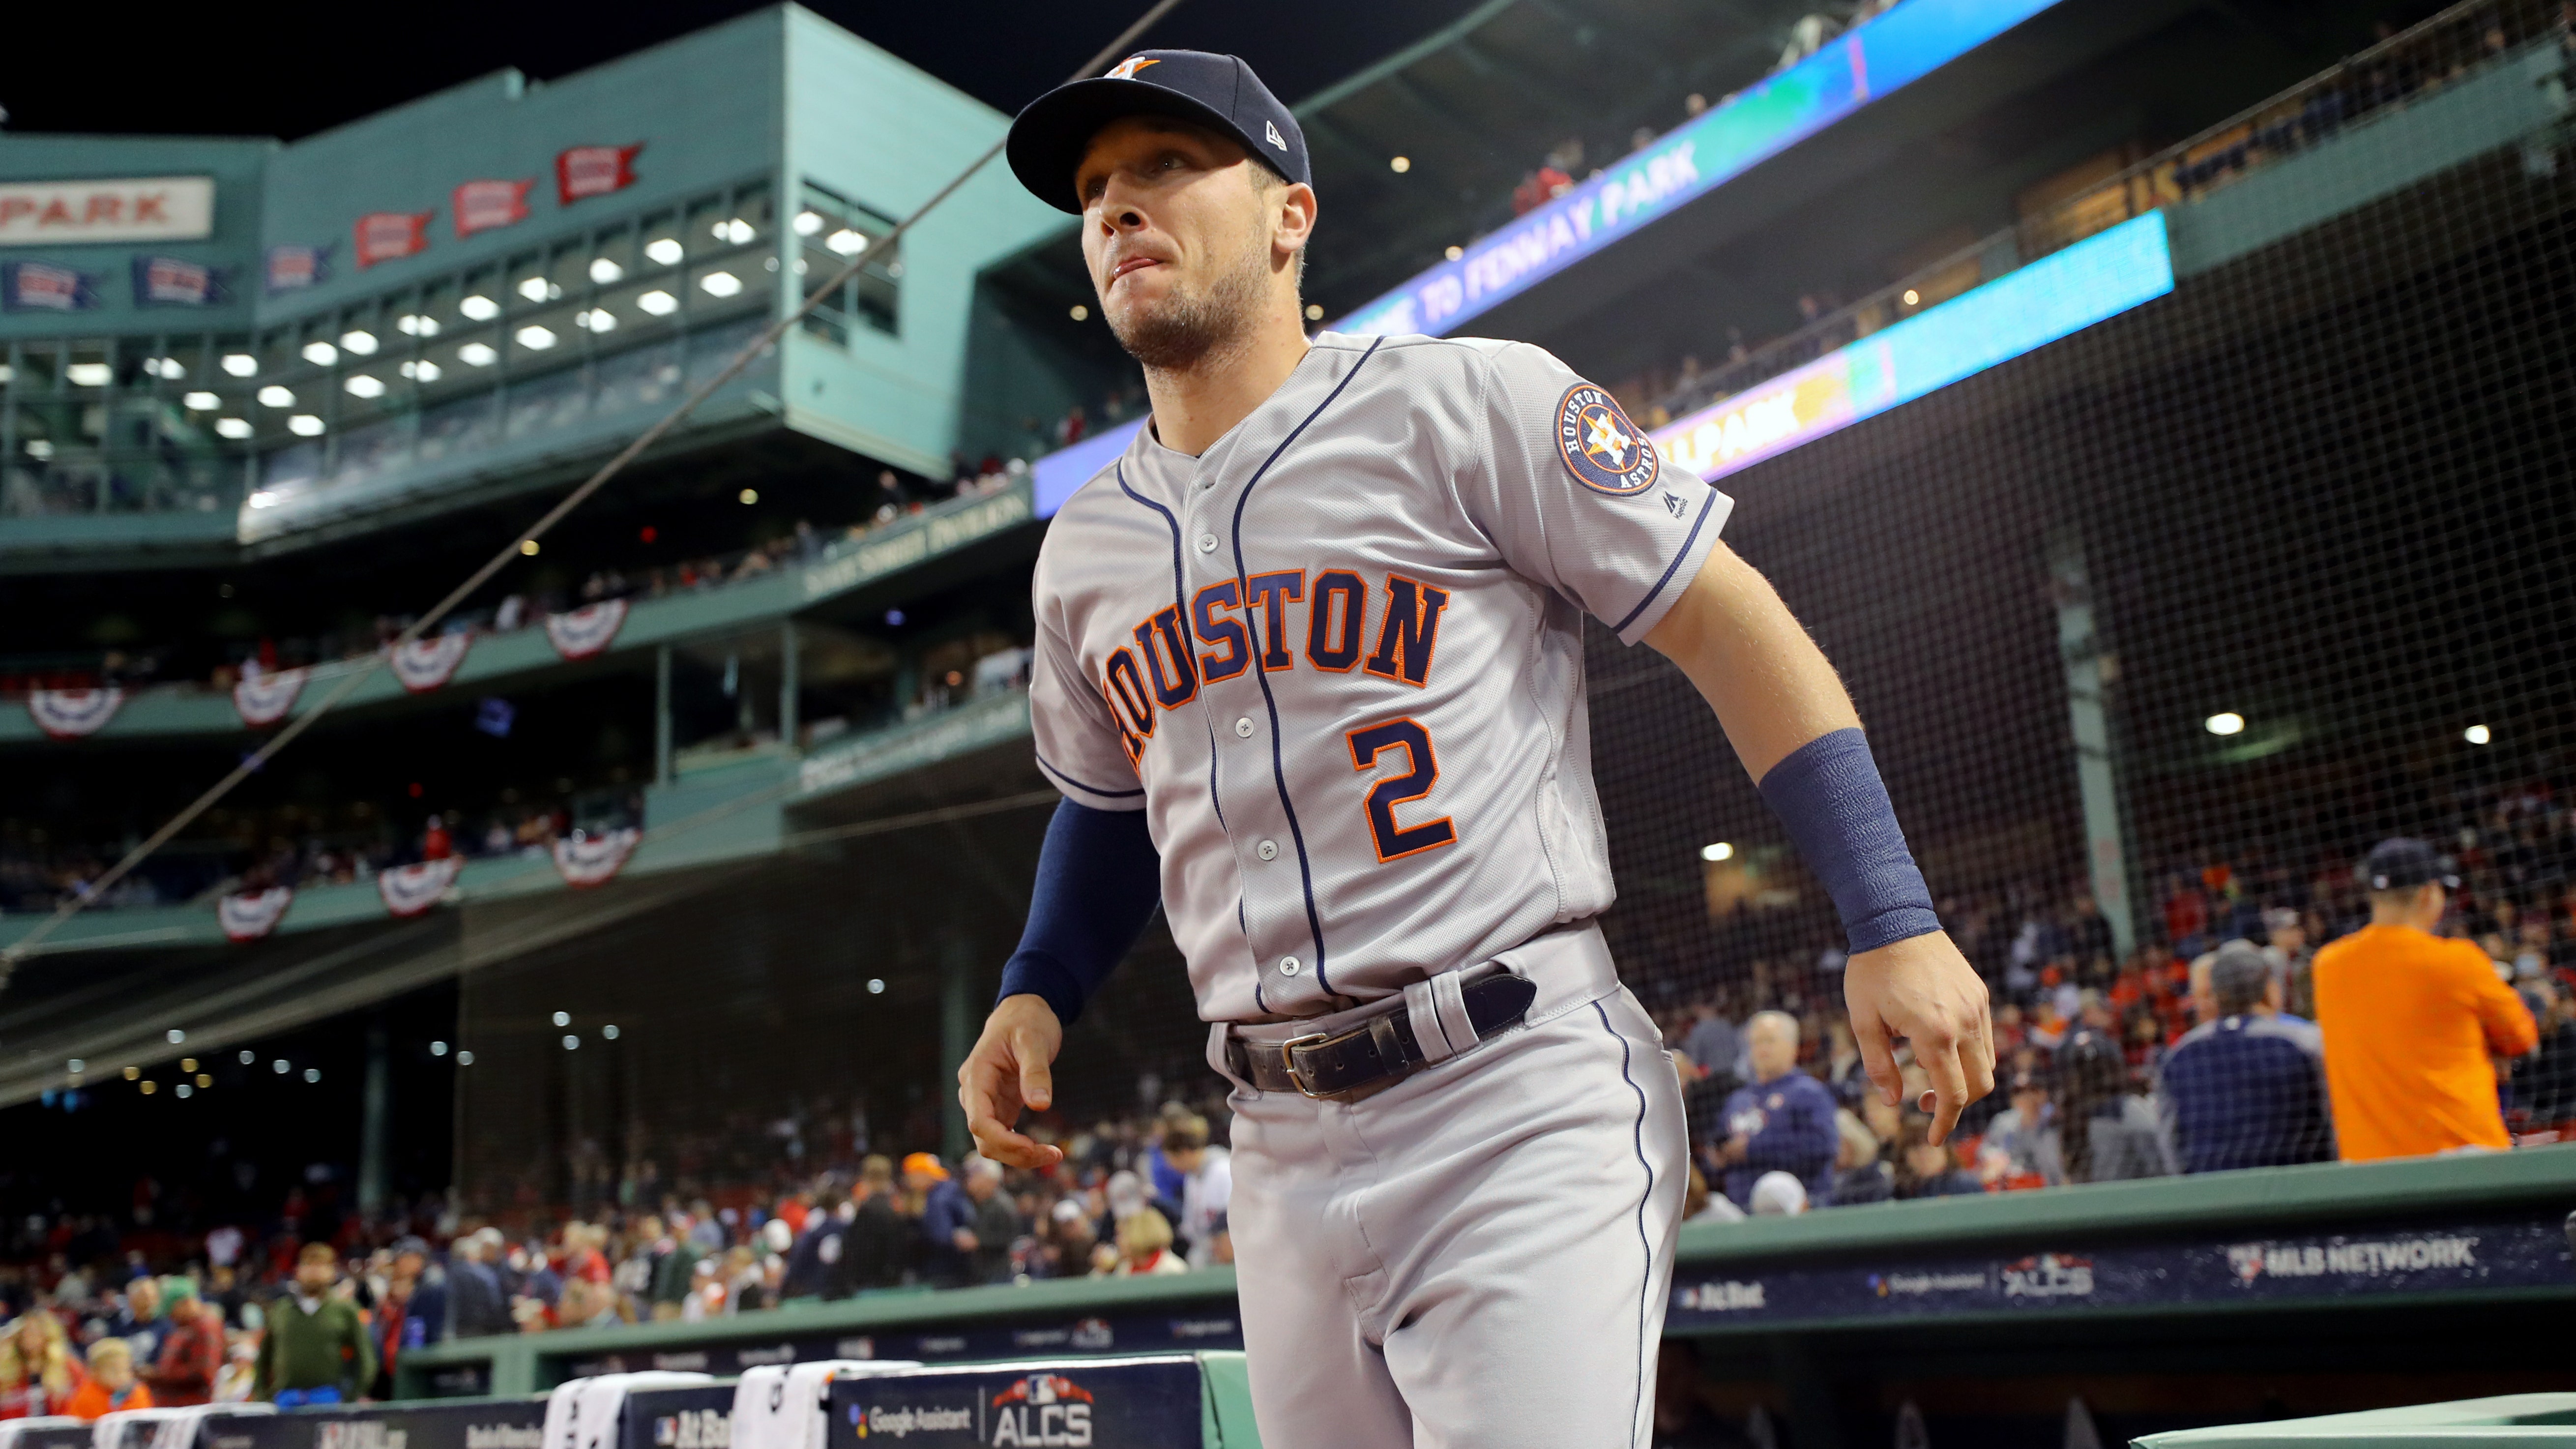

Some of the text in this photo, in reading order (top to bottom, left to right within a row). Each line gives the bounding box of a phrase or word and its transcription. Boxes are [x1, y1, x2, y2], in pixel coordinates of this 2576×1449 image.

[0, 191, 170, 230] PARK
[1419, 274, 1463, 323] TO
[1464, 195, 1594, 301] FENWAY
[1601, 141, 1699, 227] PARK
[1563, 390, 1604, 454] HOUSTON
[1620, 437, 1653, 488] ASTROS
[1673, 498, 1688, 520] Majestic
[1346, 716, 1457, 864] 2
[2266, 1238, 2477, 1277] MLB NETWORK
[1727, 1280, 1766, 1310] Bat
[674, 1409, 701, 1449] At
[869, 1405, 971, 1438] Google Assistant
[992, 1404, 1093, 1448] ALCS
